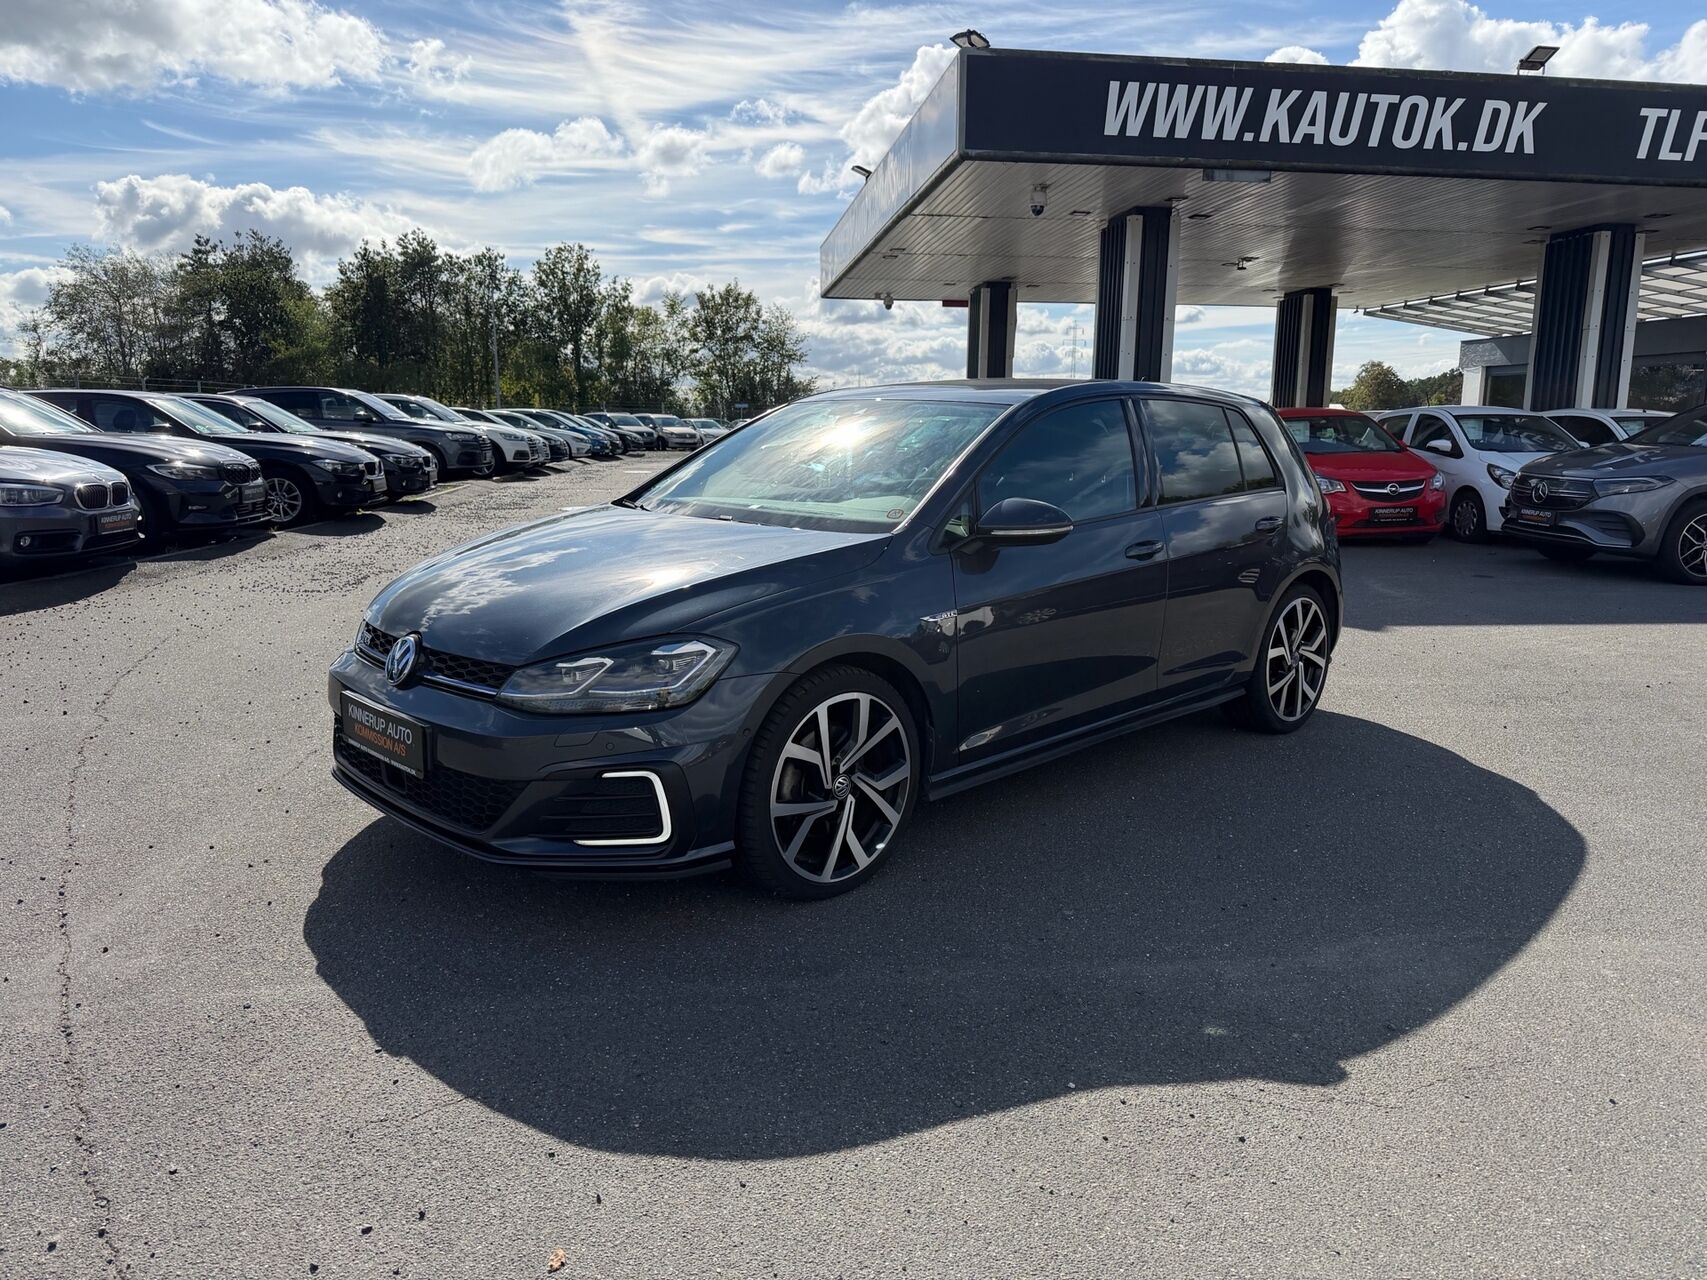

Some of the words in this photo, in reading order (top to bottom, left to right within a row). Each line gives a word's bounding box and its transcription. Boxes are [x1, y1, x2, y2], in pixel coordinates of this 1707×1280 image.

[1104, 81, 1547, 154] WWW.KAUTOK.DK
[348, 703, 386, 732] KINNERUP
[386, 722, 413, 745] AUTO
